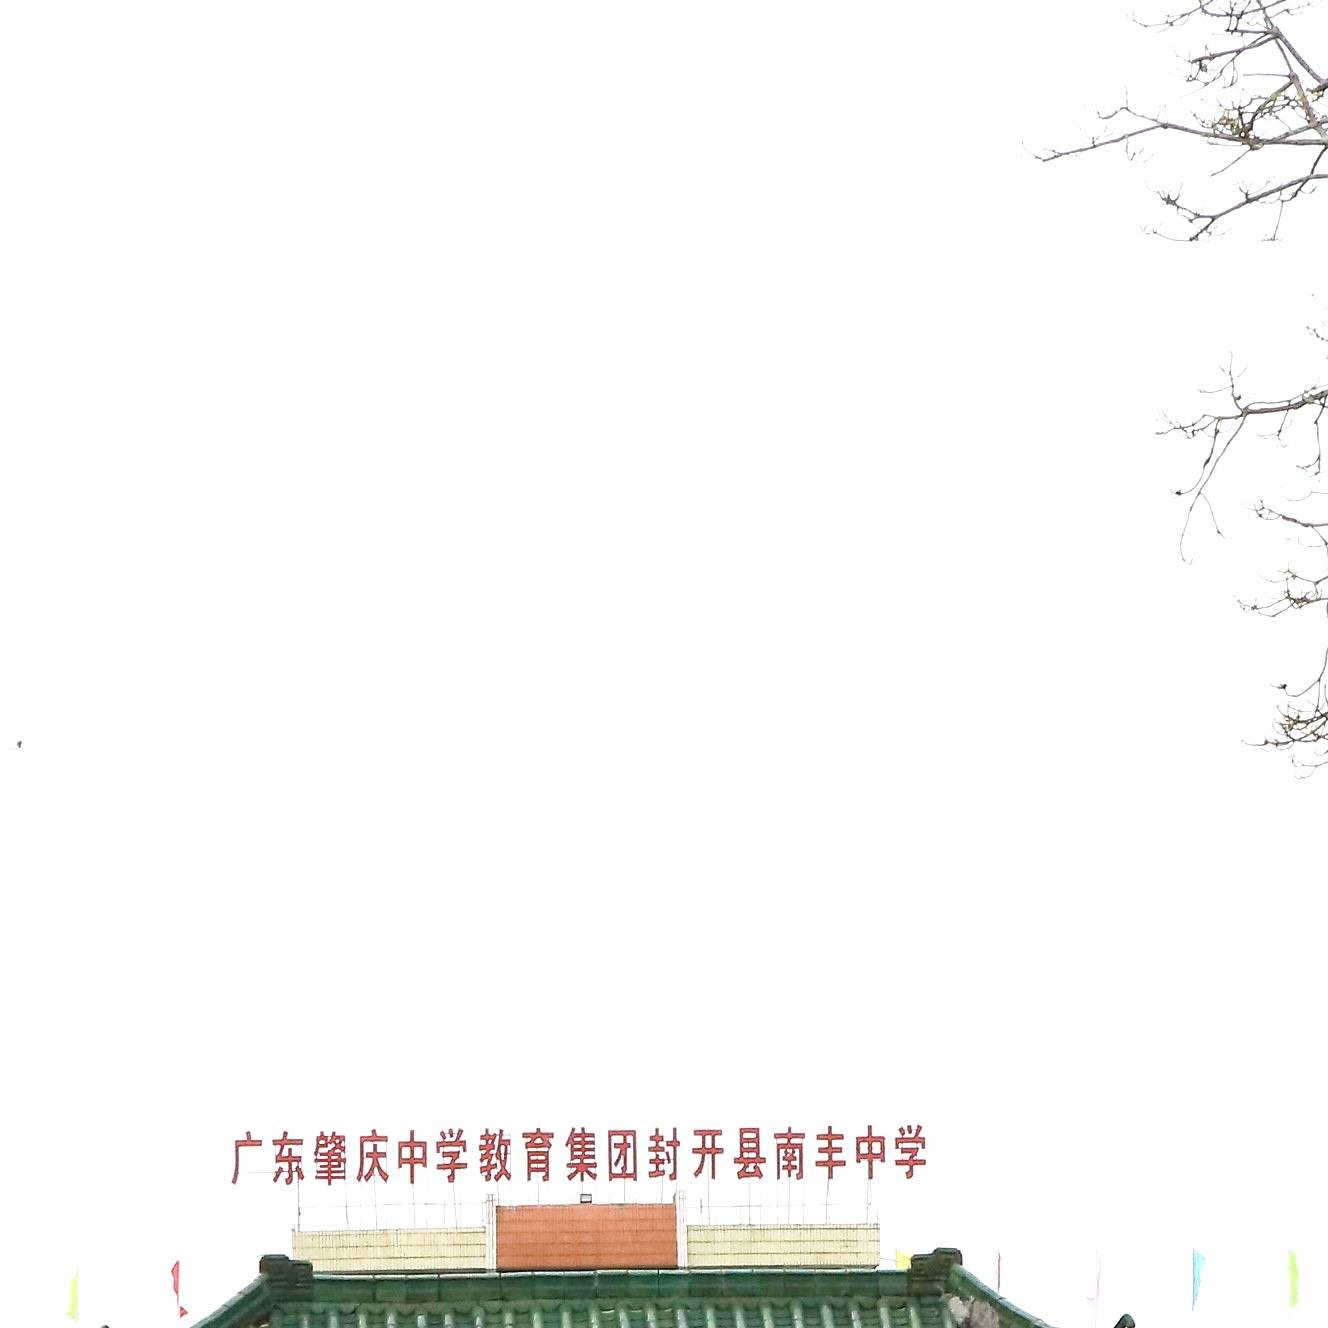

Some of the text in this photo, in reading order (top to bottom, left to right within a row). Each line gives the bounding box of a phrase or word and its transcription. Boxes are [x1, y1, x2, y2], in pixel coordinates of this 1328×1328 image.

[231, 1125, 927, 1185] 广东肇庆中学教育集团封开县南丰中学
